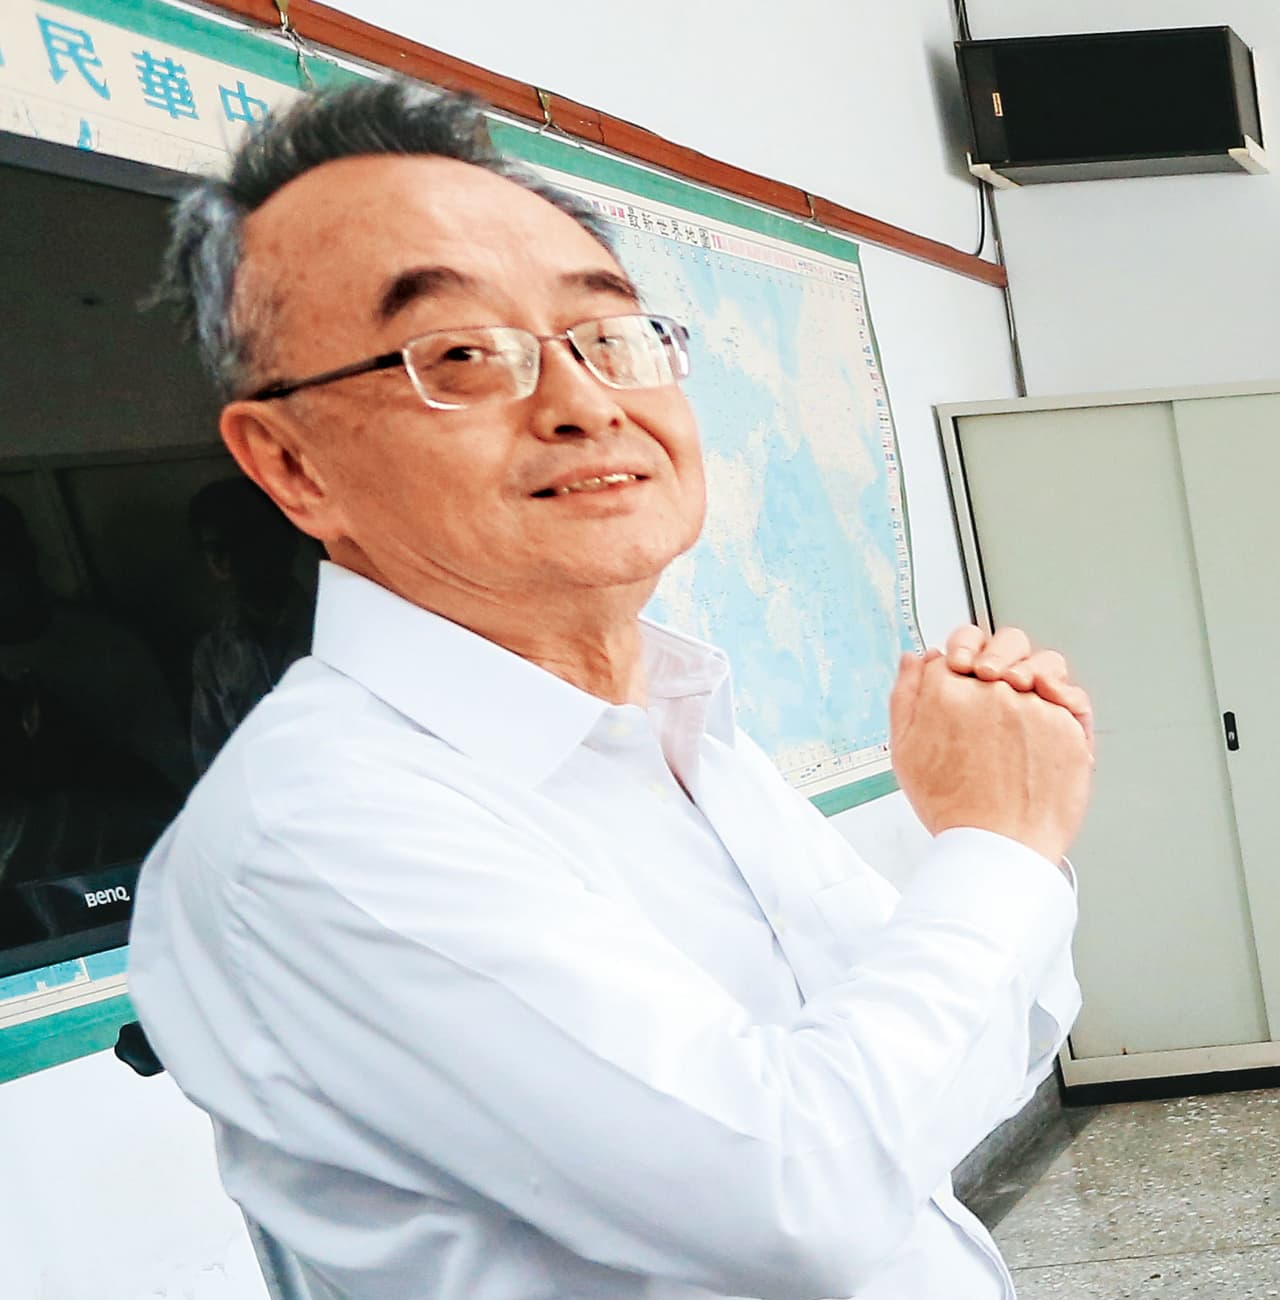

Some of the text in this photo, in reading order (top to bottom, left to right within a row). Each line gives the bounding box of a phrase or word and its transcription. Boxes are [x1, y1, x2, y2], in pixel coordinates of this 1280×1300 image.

[0, 14, 270, 125] 中華民
[84, 885, 131, 908] BenQ
